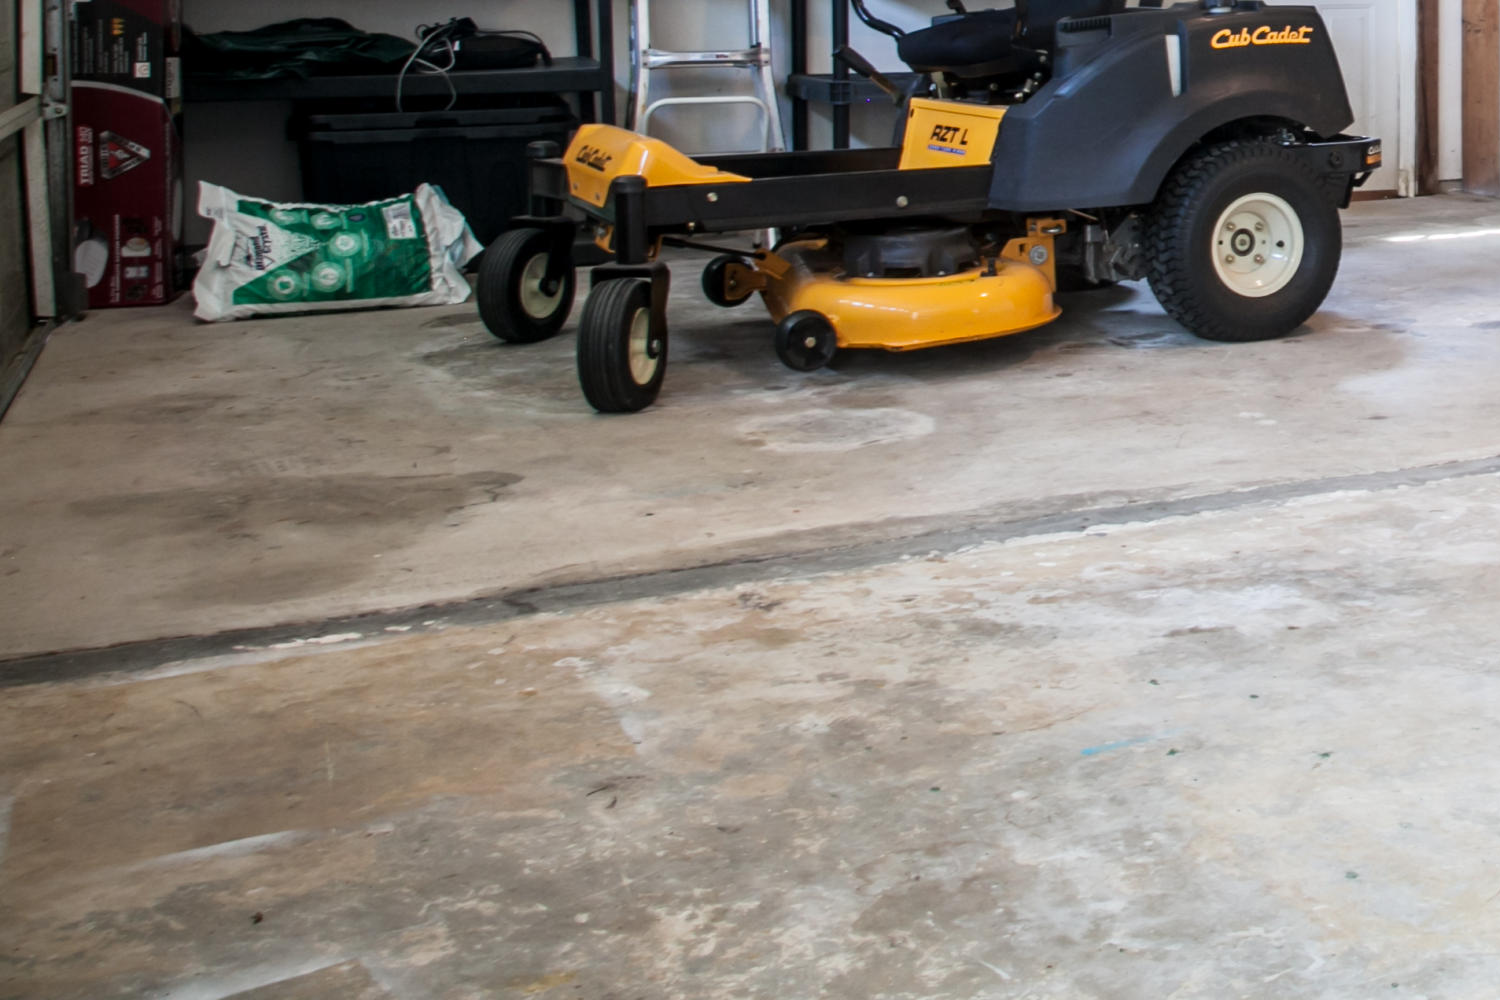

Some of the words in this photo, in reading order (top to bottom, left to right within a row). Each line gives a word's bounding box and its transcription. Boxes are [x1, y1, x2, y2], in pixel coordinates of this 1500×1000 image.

[1211, 27, 1252, 49] Cub
[1251, 25, 1314, 45] Cadet
[930, 124, 961, 143] RZT
[79, 145, 89, 185] TRIAD
